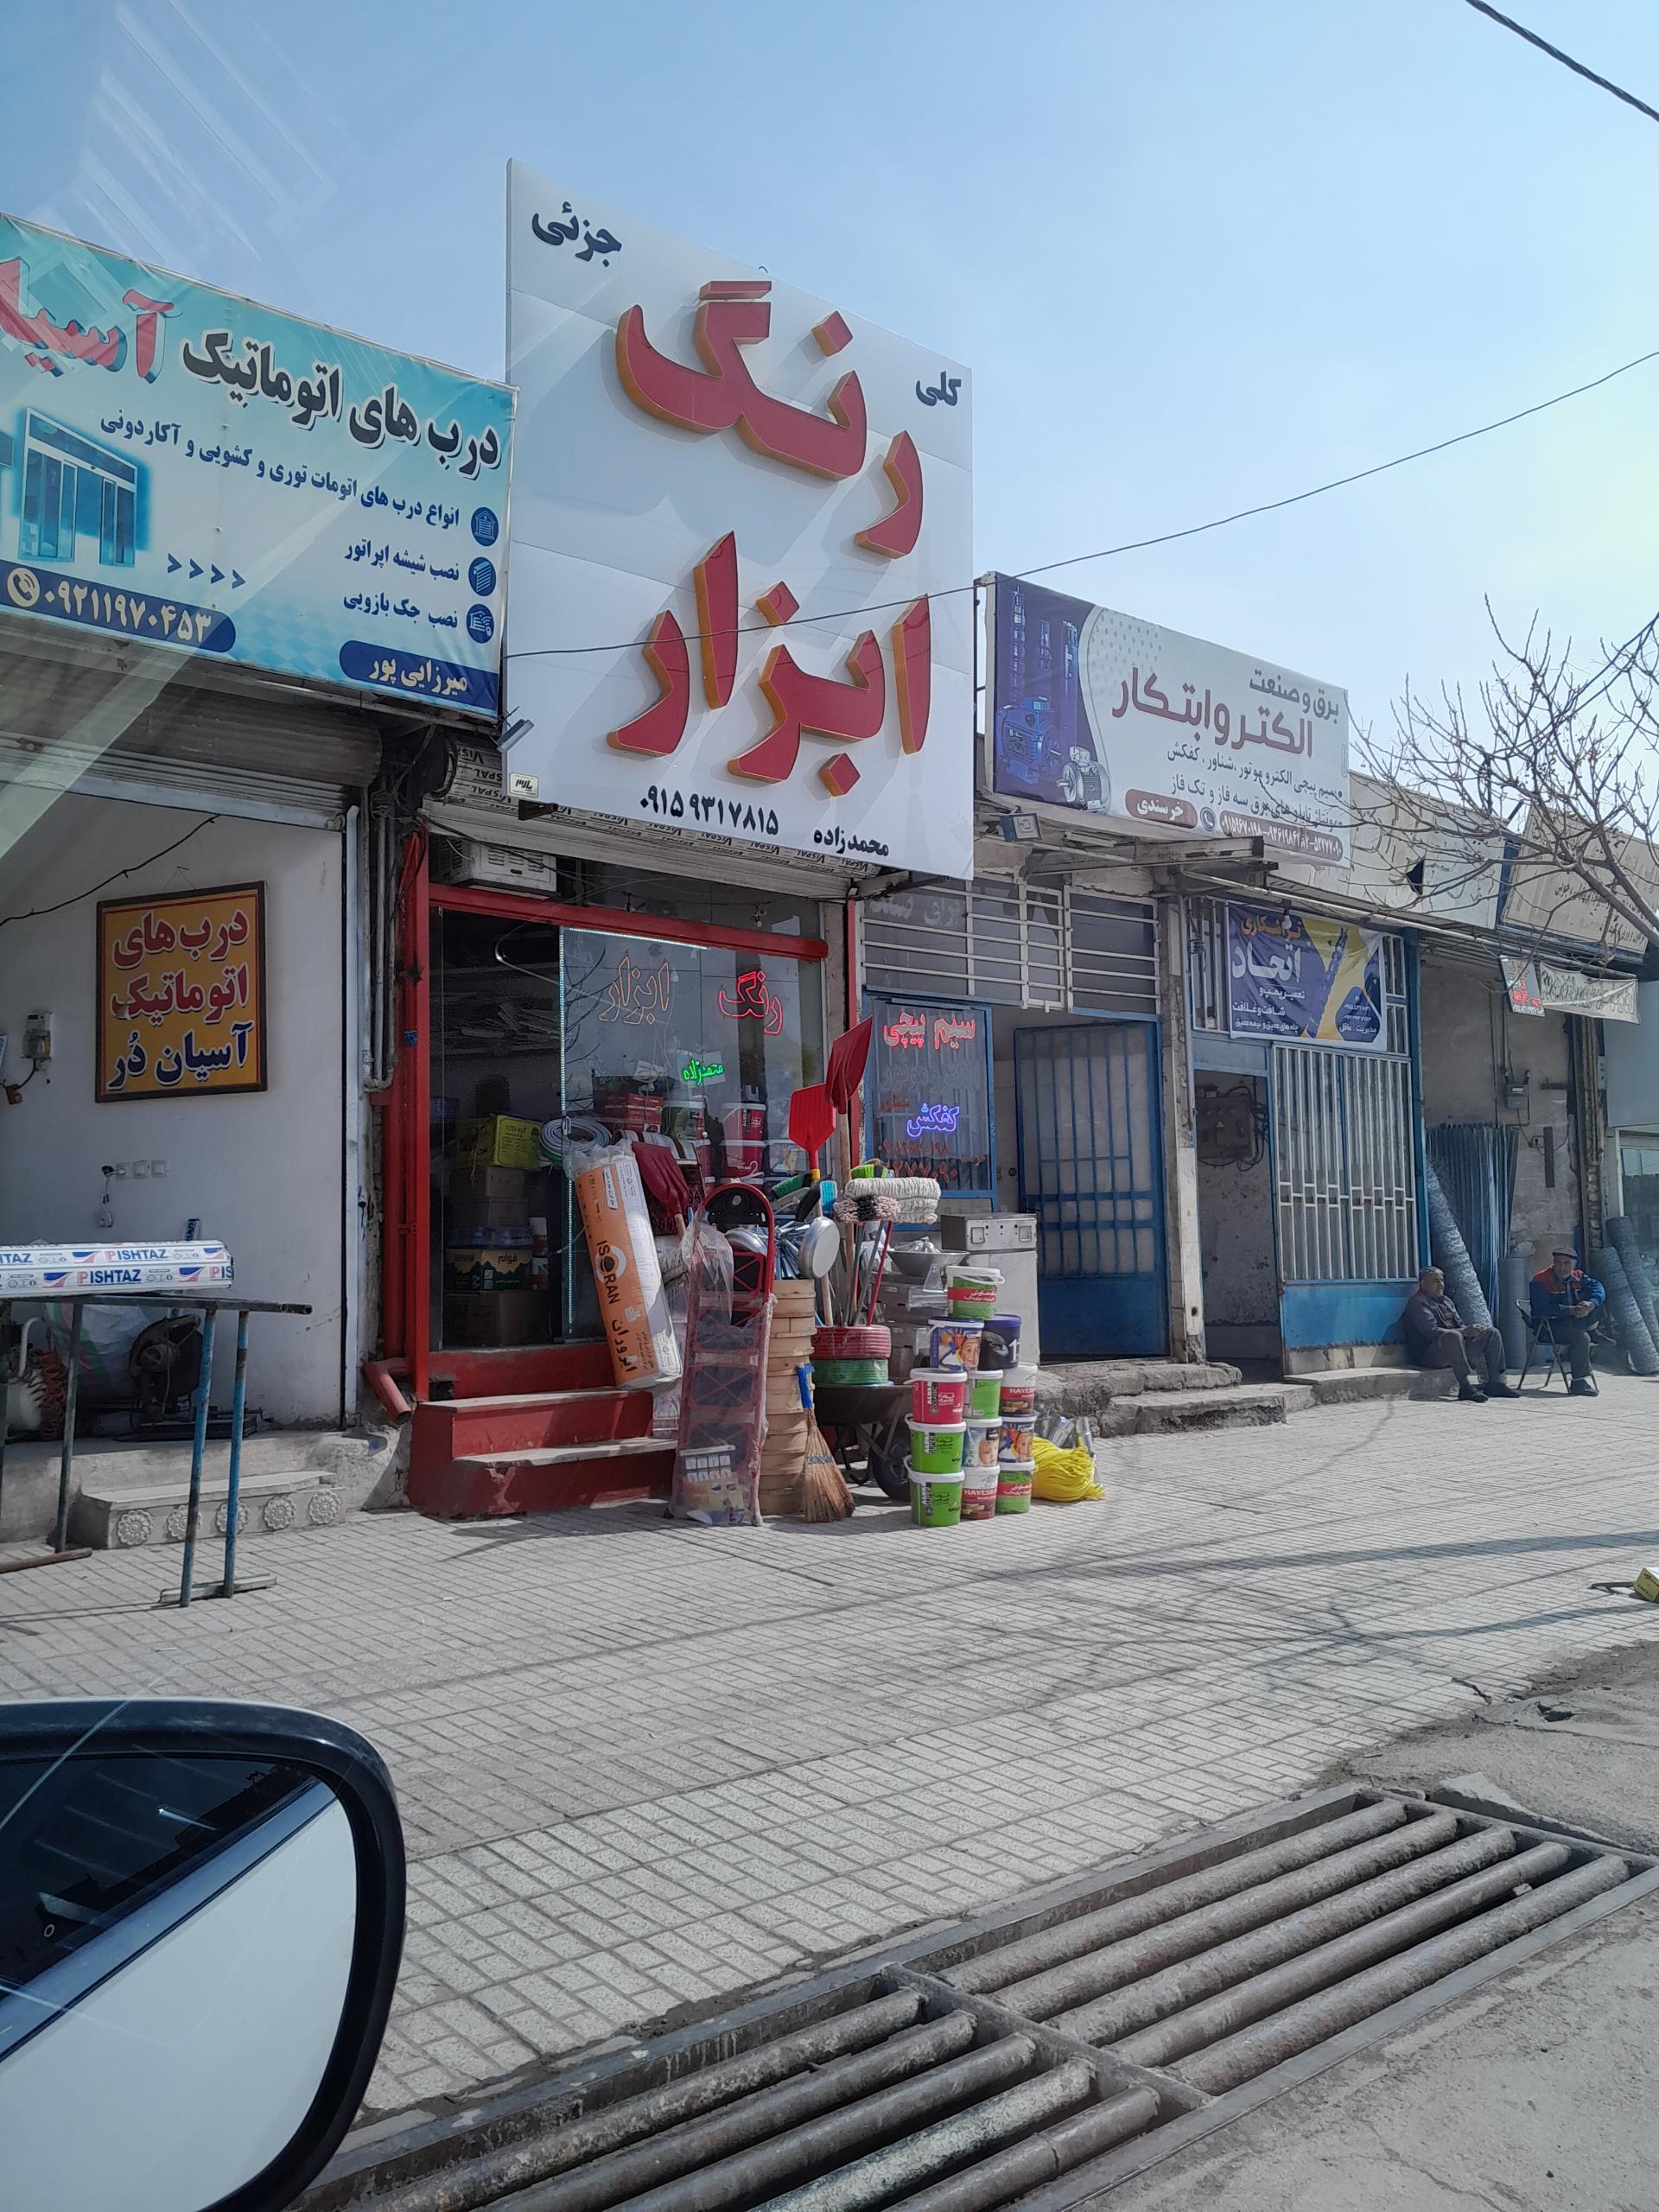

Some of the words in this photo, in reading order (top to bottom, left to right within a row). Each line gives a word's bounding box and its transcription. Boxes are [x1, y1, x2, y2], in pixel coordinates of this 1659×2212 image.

[531, 201, 622, 266] جزئی
[182, 332, 341, 428] اتوماتیک
[916, 370, 961, 407] کلی
[100, 408, 181, 446] آکاردونی
[349, 387, 417, 448] های
[615, 280, 924, 560] رنگ
[186, 439, 194, 457] و
[199, 441, 253, 467] کشویی
[429, 422, 500, 474] درب
[256, 458, 265, 478] و
[270, 466, 308, 490] توری
[311, 470, 358, 502] اتومات
[360, 485, 389, 507] های
[392, 499, 423, 523] درب
[426, 505, 460, 526] انواع
[345, 540, 390, 570] اپراتور
[392, 550, 426, 574] شیشه
[429, 561, 460, 583] نصب
[343, 590, 391, 616] بازویی
[393, 598, 421, 620] جک
[428, 607, 458, 629] نصب
[369, 652, 396, 683] پور
[400, 654, 467, 694] میرزایی
[607, 530, 931, 798] ابزار
[1249, 668, 1300, 701] صنعت
[1112, 667, 1210, 741] ابتکار
[1313, 689, 1339, 724] برق
[1214, 702, 1313, 758] الکترو
[1171, 773, 1185, 794] فاز
[1188, 779, 1206, 795] تک
[1217, 785, 1230, 805] فاز
[1136, 795, 1184, 823] خرسندی
[813, 826, 890, 857] محمدزاده
[1232, 942, 1301, 982] اتحاد
[111, 963, 248, 1024] اتوماتیک
[599, 955, 670, 1025] ابزار
[719, 970, 783, 1035] رنگ
[883, 1011, 927, 1050] پیچی
[934, 1017, 976, 1050] سیم
[156, 1022, 252, 1084] آسیان
[906, 1102, 961, 1139] کفکش
[105, 1249, 168, 1262] PISHTAZ
[77, 1269, 141, 1285] PISHTAZ
